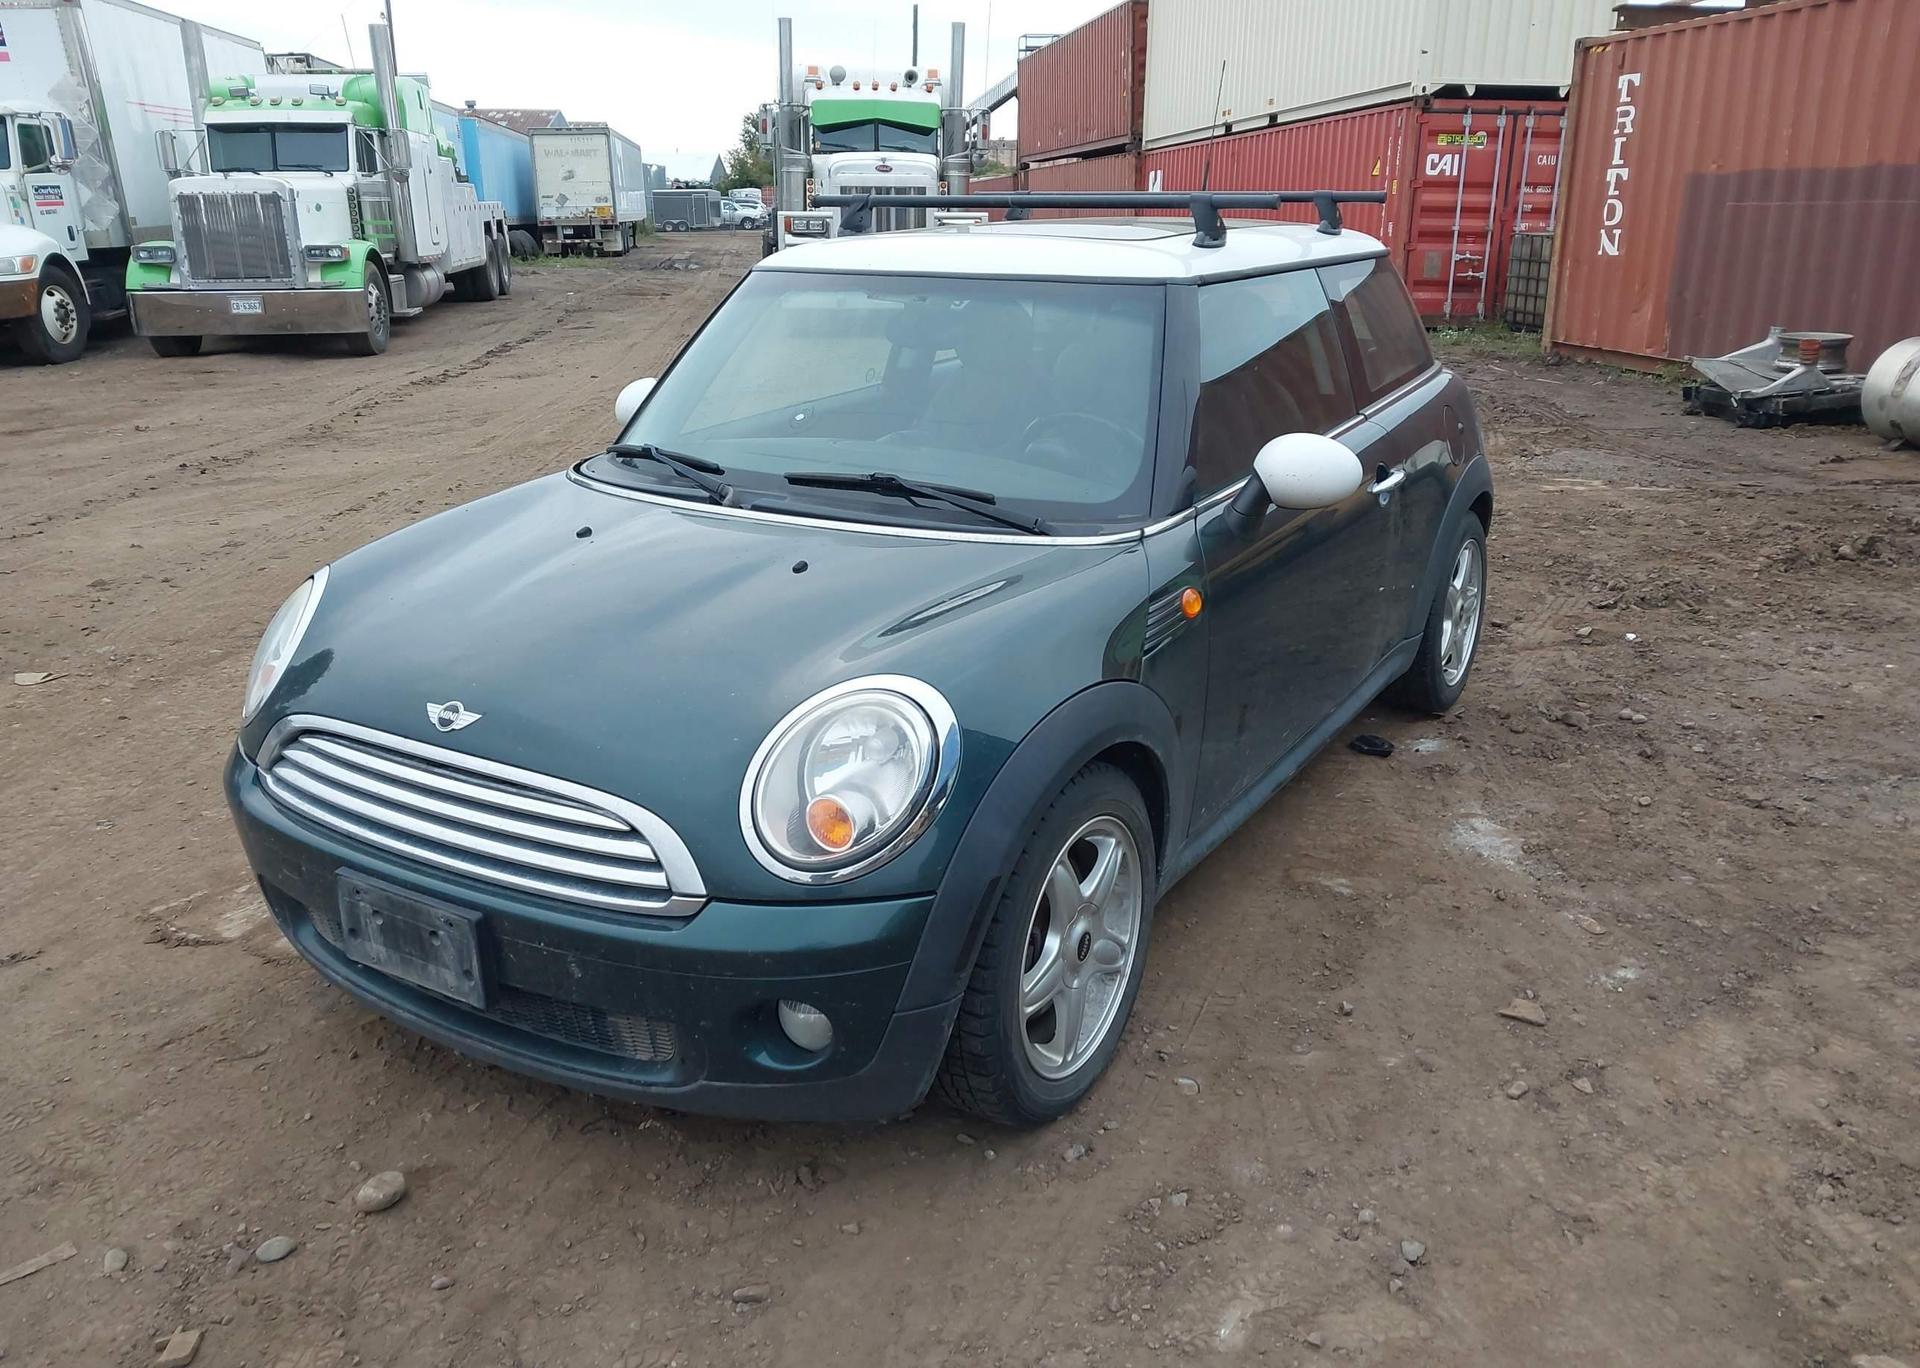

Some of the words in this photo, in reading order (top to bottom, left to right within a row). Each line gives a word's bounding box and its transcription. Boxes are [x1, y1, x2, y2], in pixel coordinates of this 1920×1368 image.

[1447, 134, 1486, 144] STROGBOX
[1426, 154, 1460, 176] CAI
[1537, 155, 1557, 166] CAIU
[1598, 73, 1641, 256] TRITON
